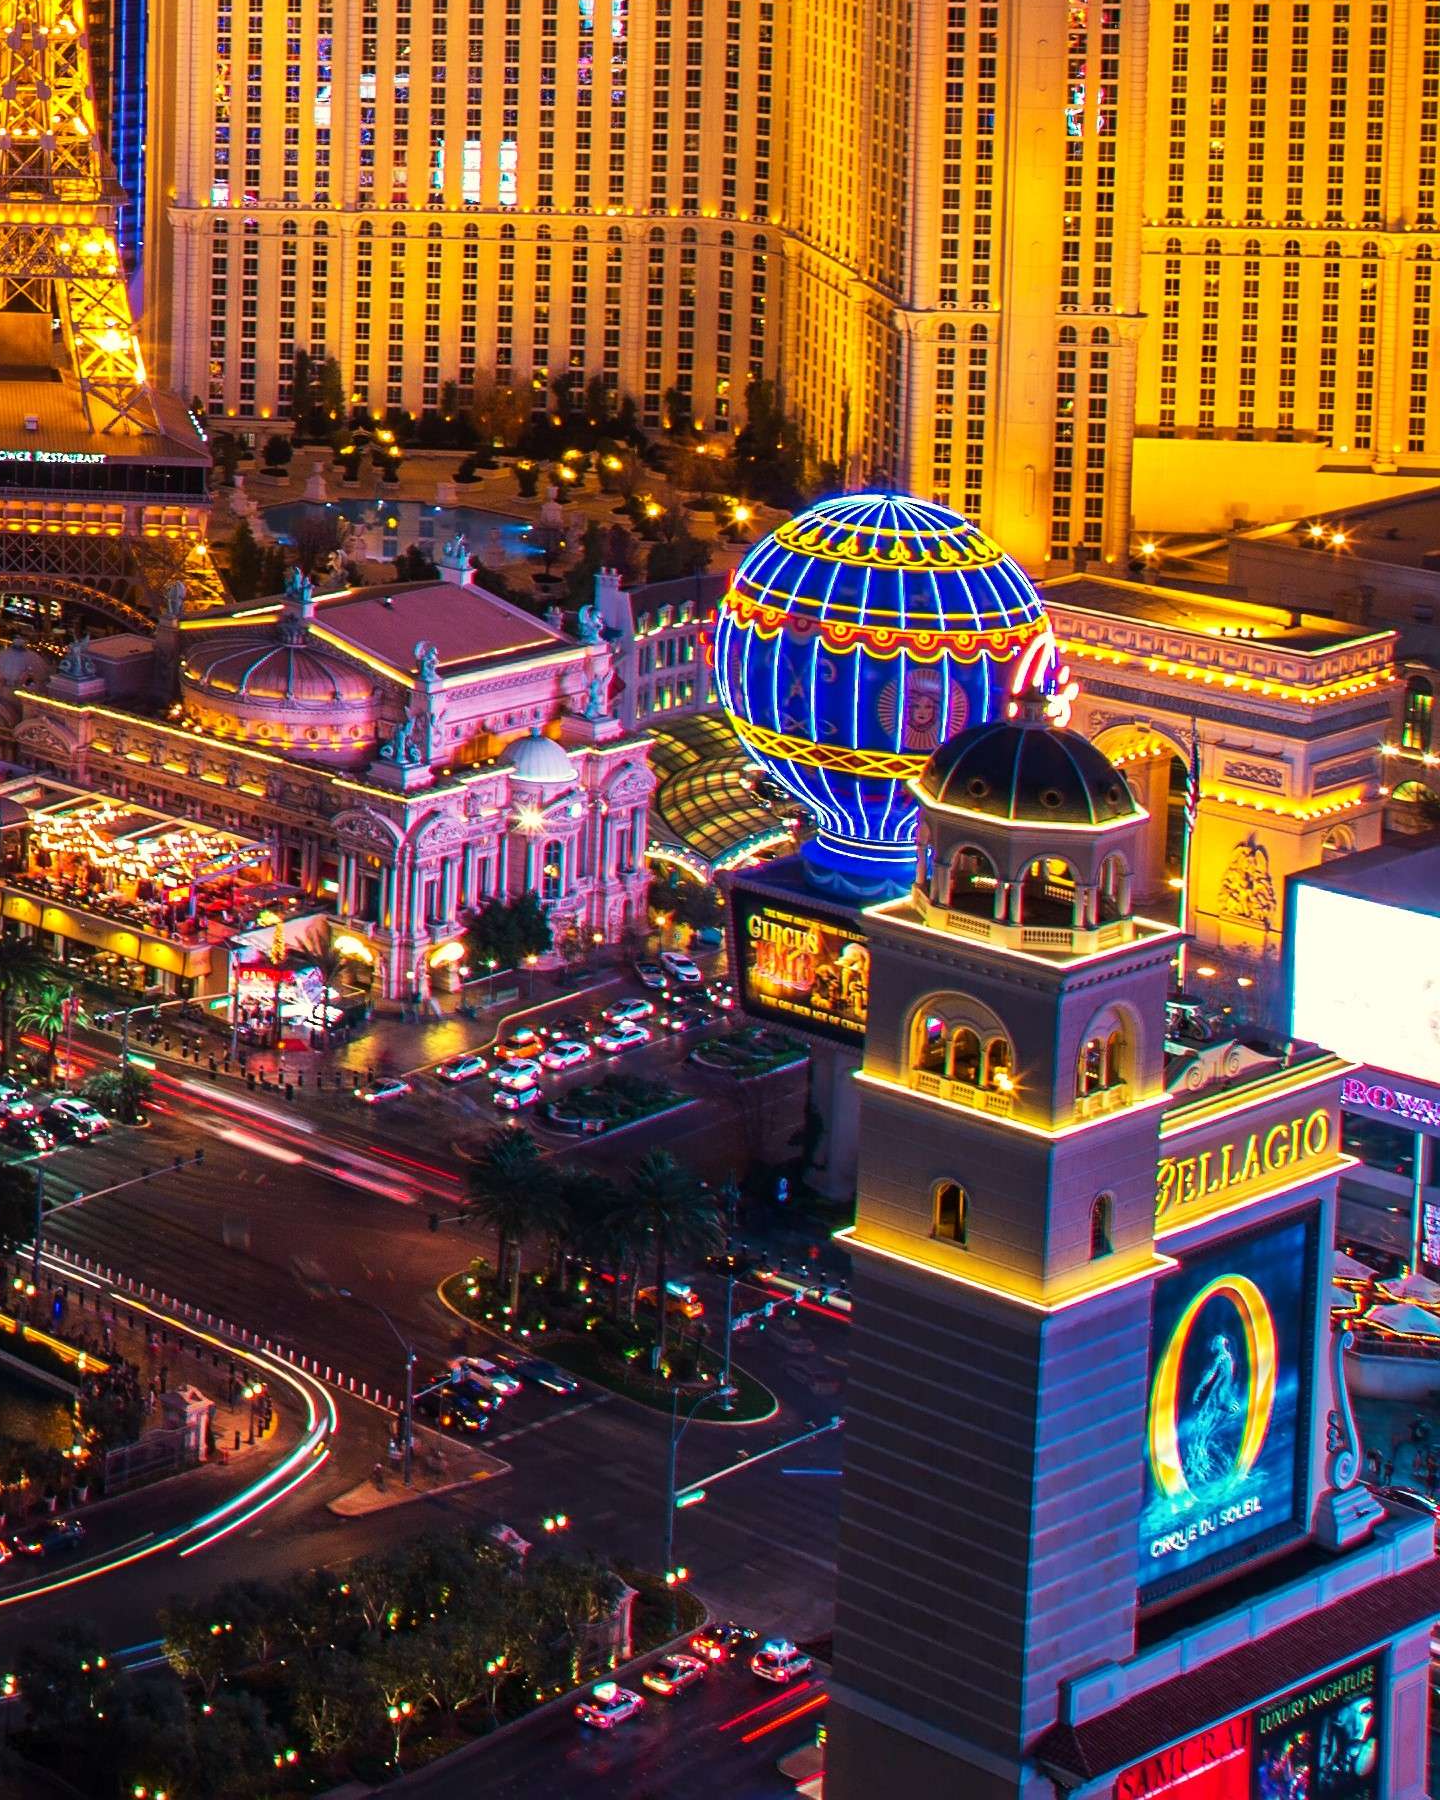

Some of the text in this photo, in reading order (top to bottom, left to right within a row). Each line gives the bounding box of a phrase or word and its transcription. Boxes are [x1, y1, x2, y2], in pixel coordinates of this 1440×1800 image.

[35, 450, 108, 464] RESTAURANT
[747, 914, 819, 955] CIRCUS
[1150, 1495, 1263, 1558] CIRQUE DU SOLEIL
[1260, 1698, 1307, 1735] LUXURY
[1308, 1664, 1377, 1710] NIGHTLIFE
